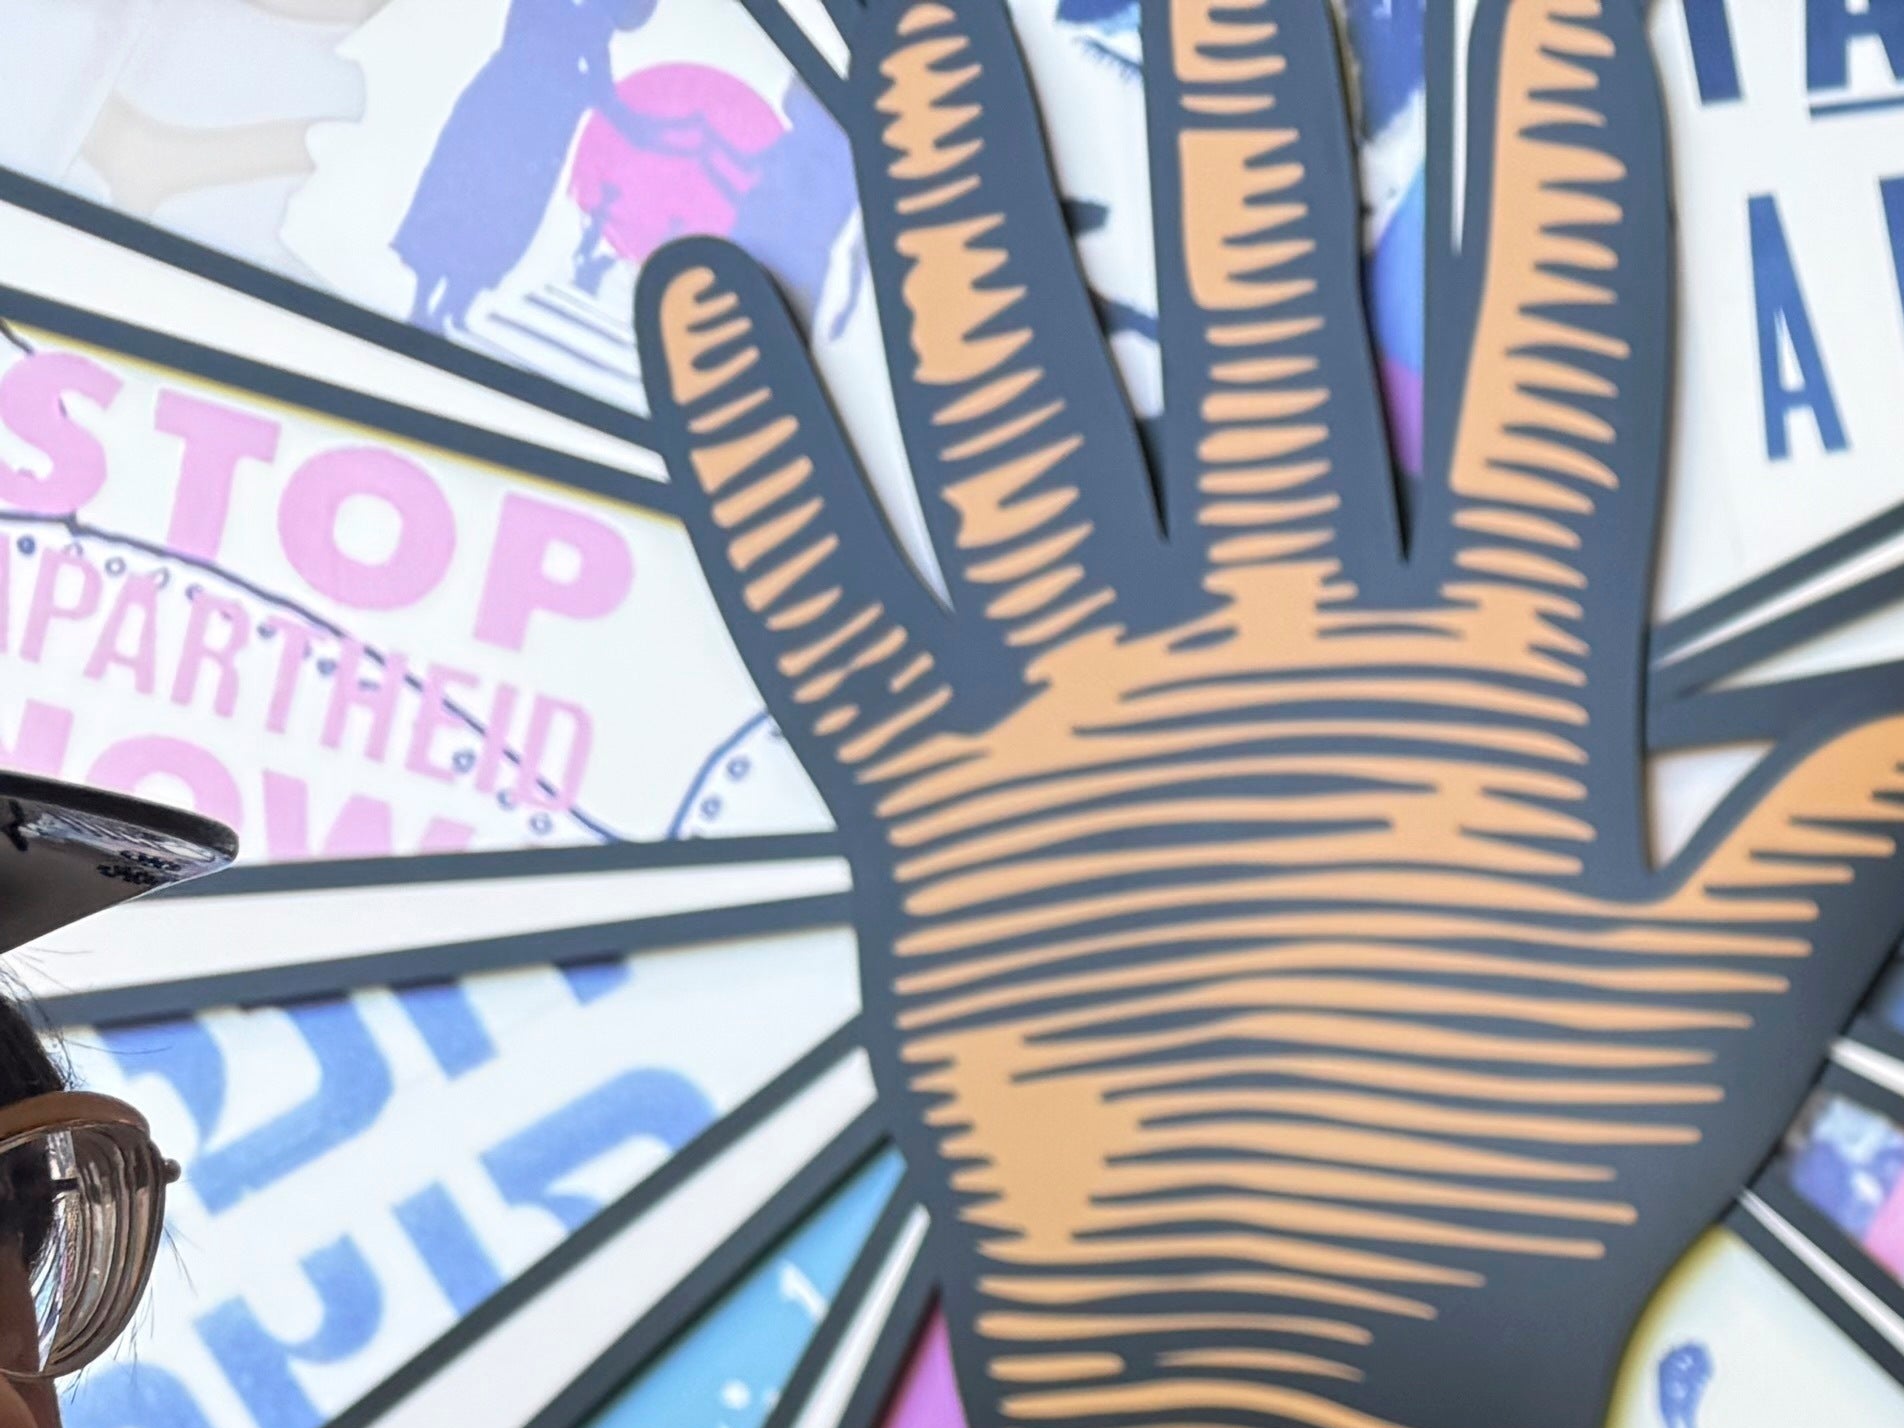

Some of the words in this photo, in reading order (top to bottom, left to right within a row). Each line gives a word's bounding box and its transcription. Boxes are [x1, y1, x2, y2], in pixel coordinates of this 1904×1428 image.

[1745, 192, 1852, 462] A
[0, 350, 636, 652] STOP
[0, 532, 595, 812] PARTHEID
